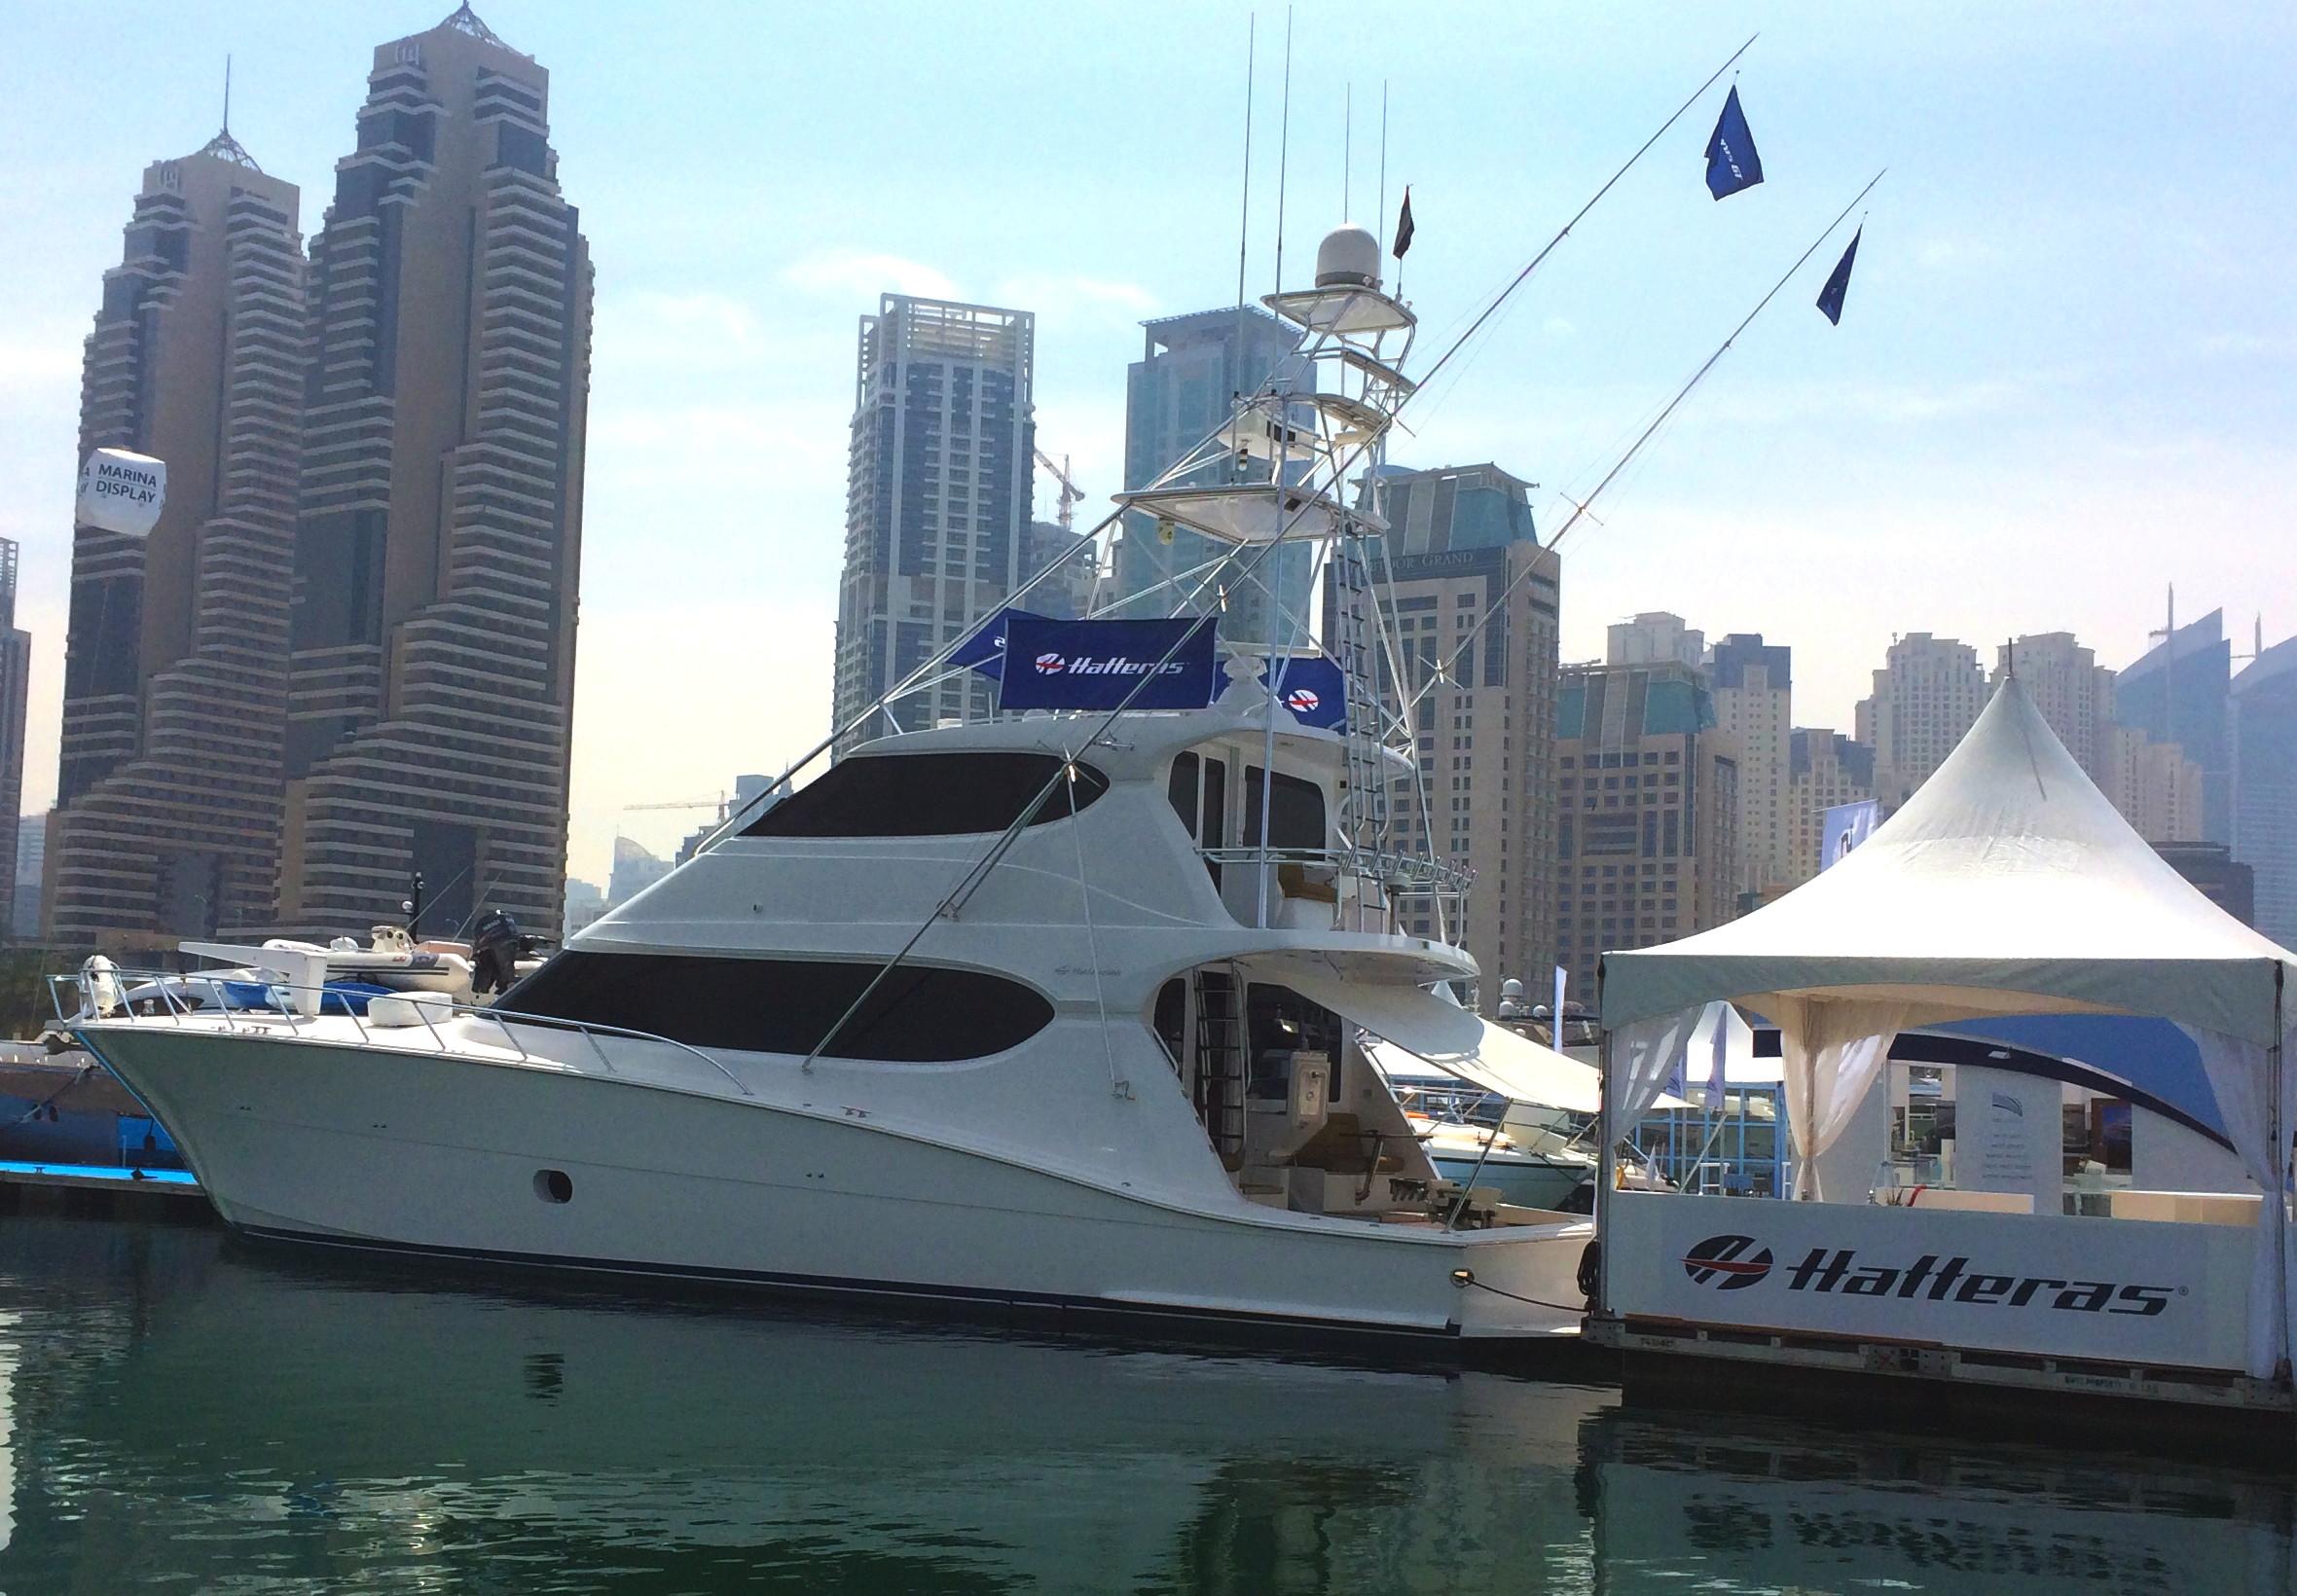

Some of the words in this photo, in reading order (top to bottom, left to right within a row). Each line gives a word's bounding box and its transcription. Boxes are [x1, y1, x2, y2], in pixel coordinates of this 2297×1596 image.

[98, 463, 156, 488] MARINA
[95, 480, 156, 503] DISPLAY
[1421, 552, 1474, 568] GRAND
[1785, 1248, 2174, 1316] Hatteras
